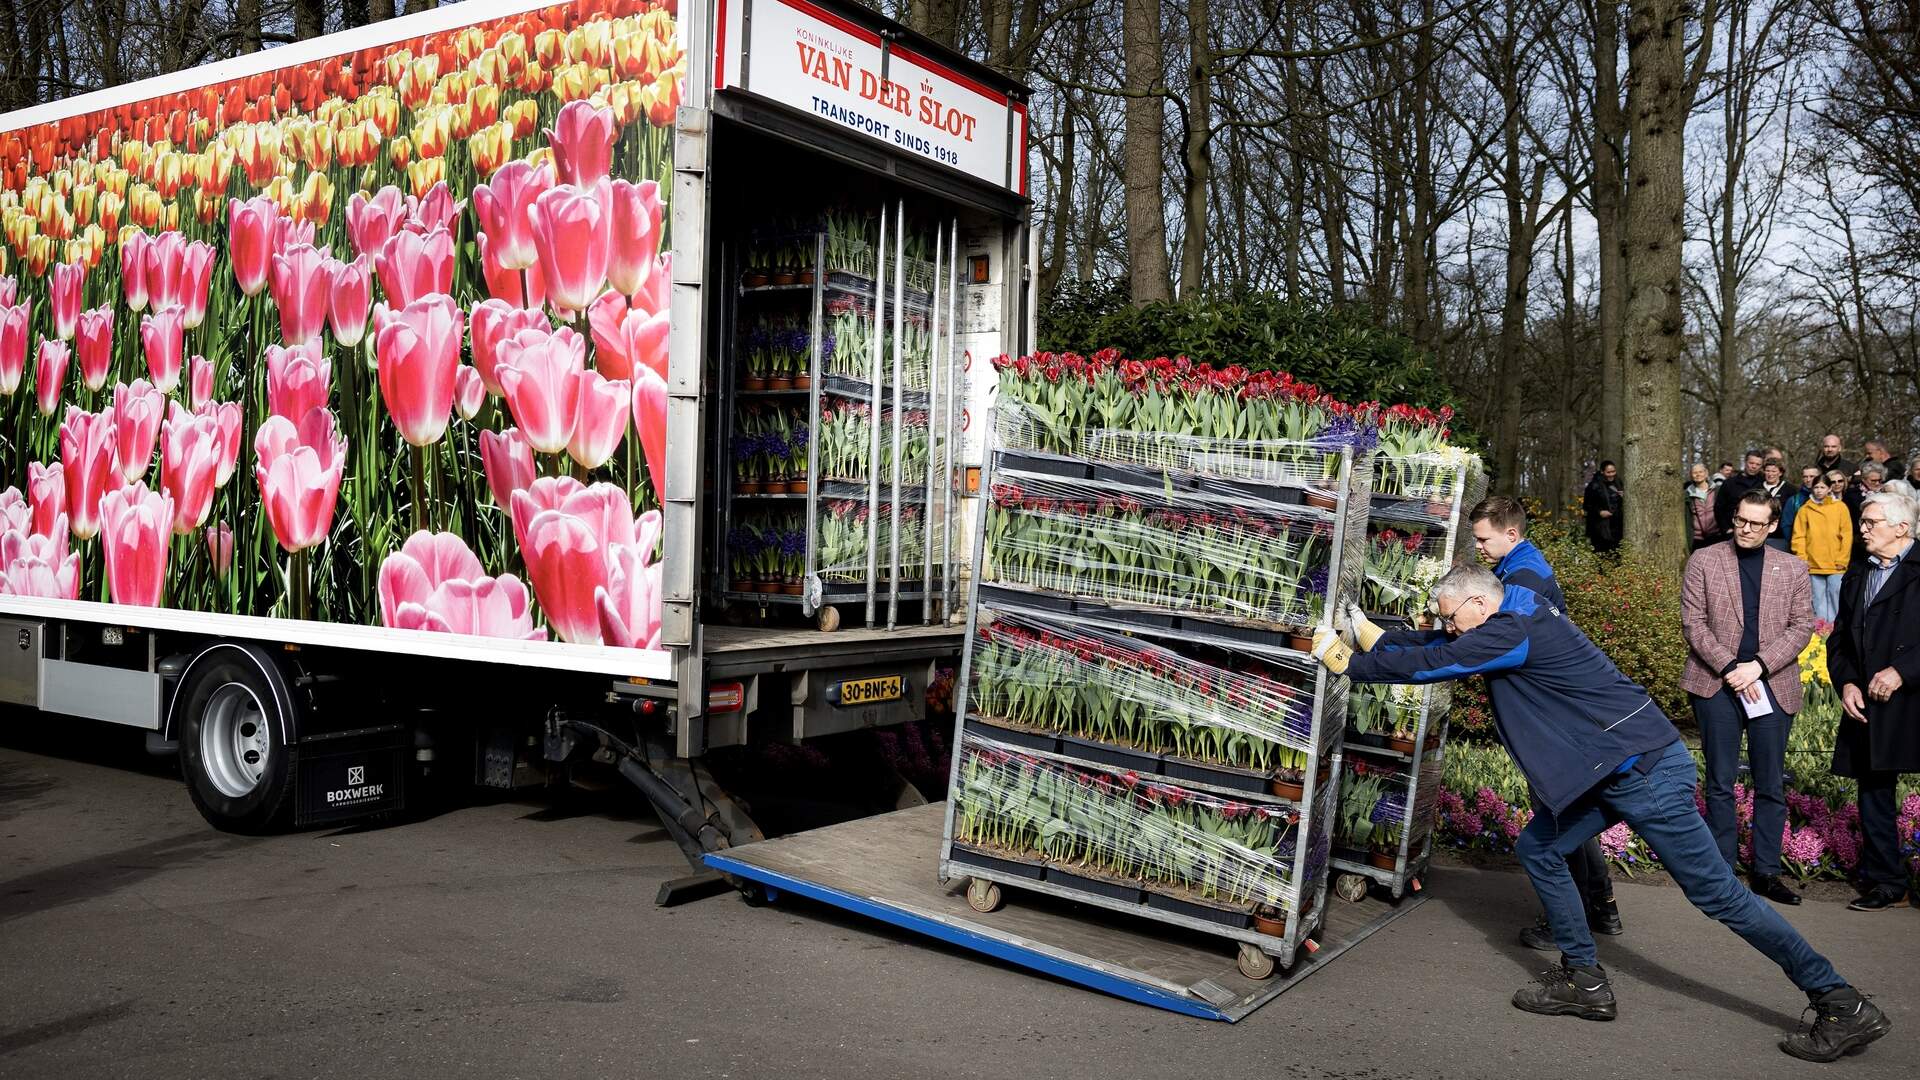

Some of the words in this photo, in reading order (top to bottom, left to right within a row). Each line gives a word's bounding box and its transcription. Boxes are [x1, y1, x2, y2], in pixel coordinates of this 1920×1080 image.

[796, 27, 853, 60] KONINKLIJKE
[796, 40, 852, 91] VAN
[859, 68, 912, 117] DER
[919, 95, 977, 142] SLOT
[812, 96, 890, 138] TRANSPORT
[894, 129, 930, 155] SINDS
[934, 145, 958, 165] 1918
[843, 680, 899, 701] 30-BNF-6
[327, 784, 383, 802] BOXWERK
